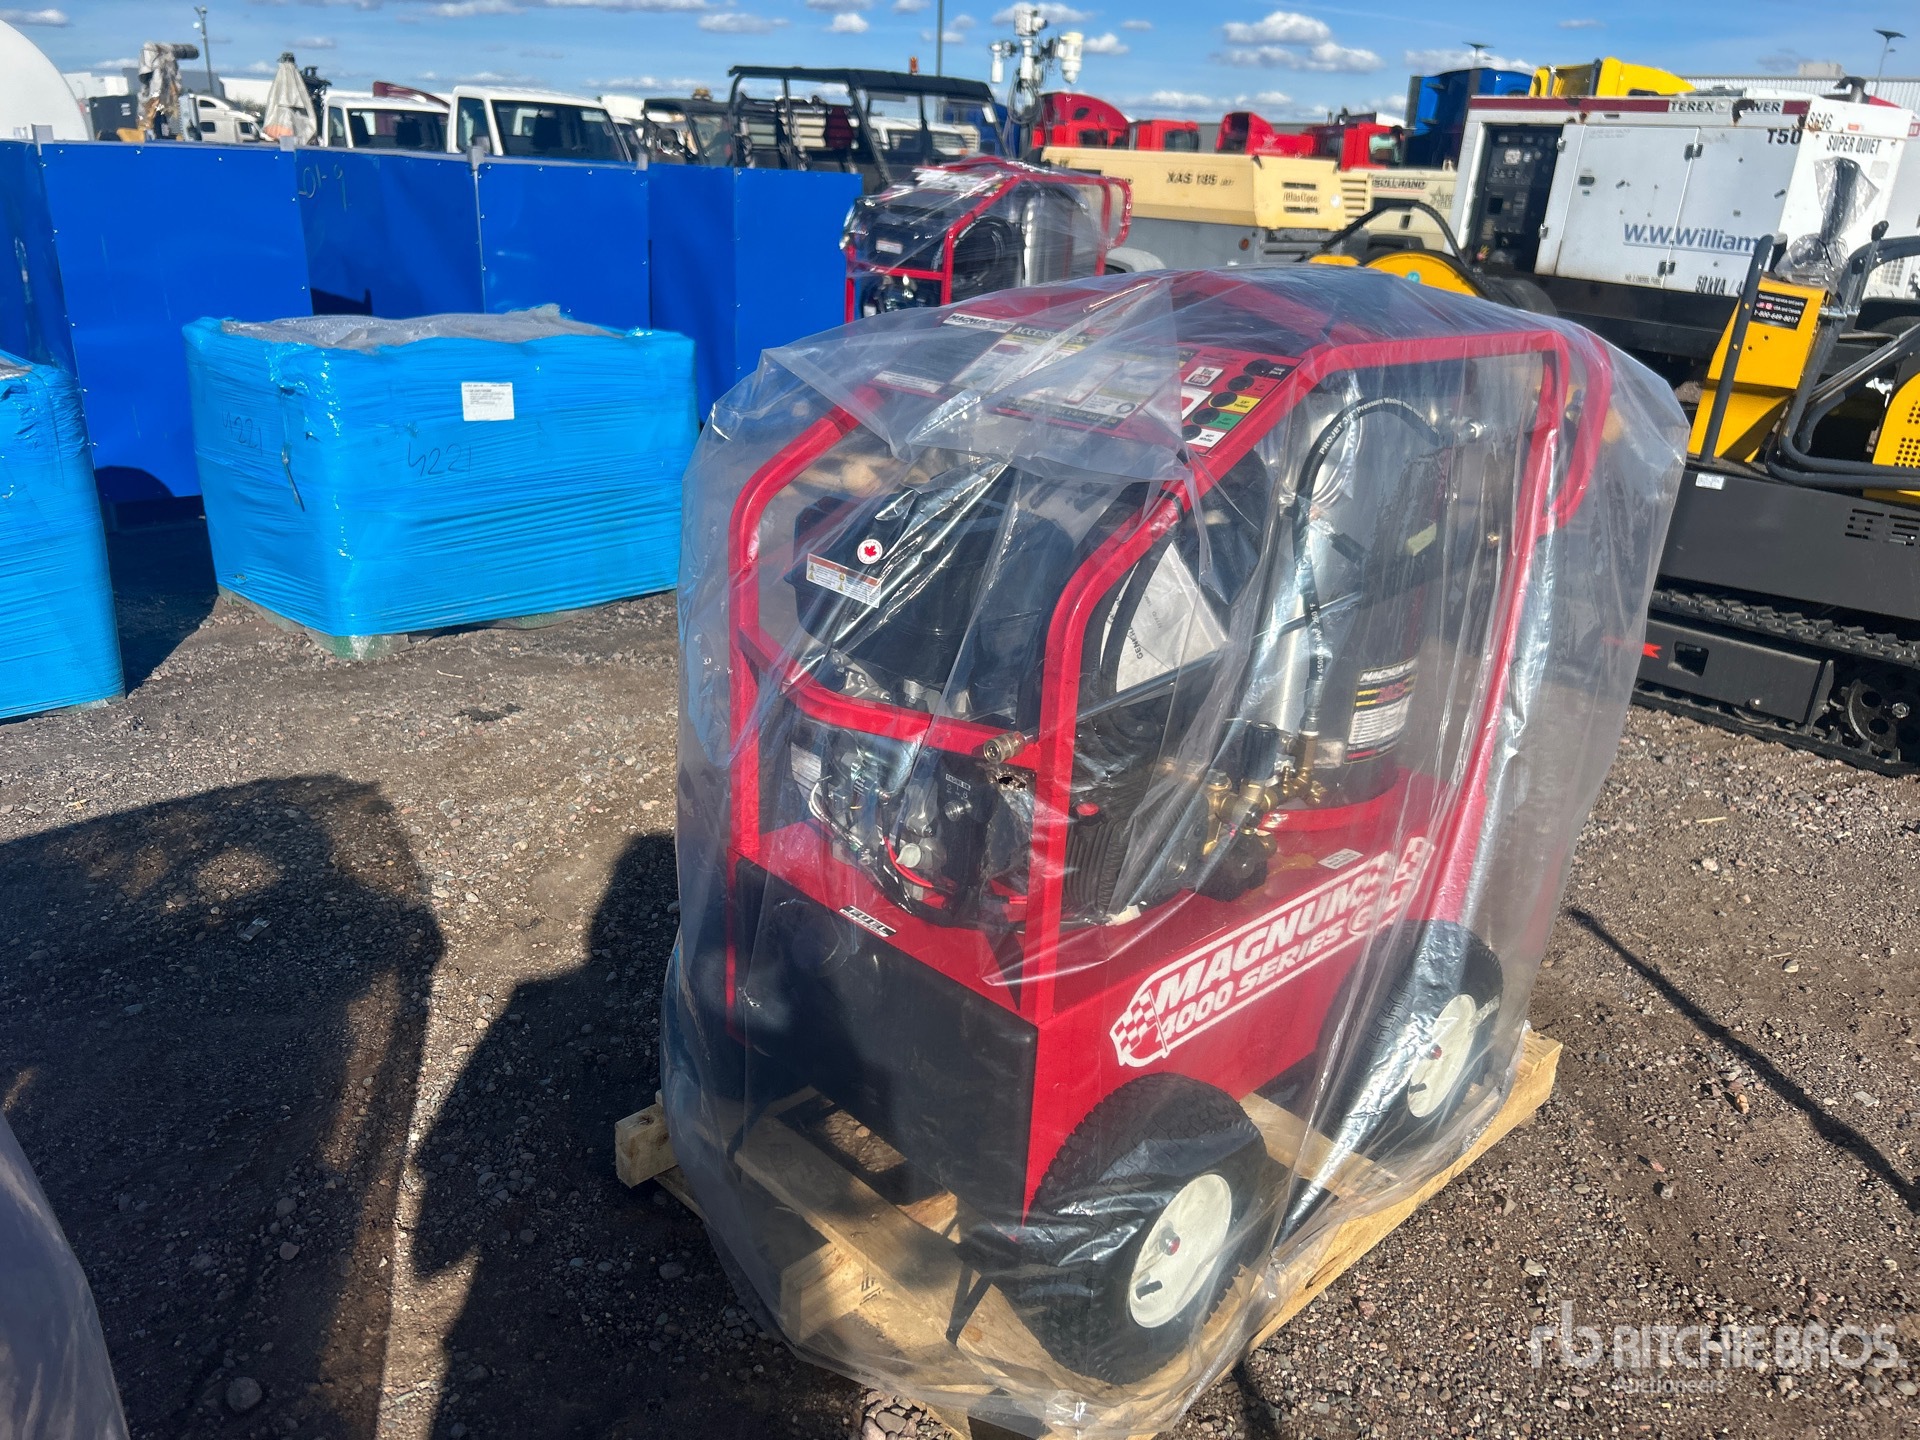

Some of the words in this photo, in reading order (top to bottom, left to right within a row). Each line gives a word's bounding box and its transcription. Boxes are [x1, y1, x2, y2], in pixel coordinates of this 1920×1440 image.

[1671, 101, 1714, 112] TEREX
[1826, 134, 1856, 153] SUPER
[1855, 136, 1882, 154] QUIET
[1166, 171, 1193, 184] XAS
[1013, 326, 1088, 344] ACCESSOES
[1319, 423, 1343, 455] PROJET
[1356, 398, 1384, 414] Pressure
[1316, 655, 1324, 674] 4500
[1156, 873, 1386, 1014] MAGNUM
[1156, 981, 1232, 1042] 4000
[1236, 917, 1344, 998] SERIES
